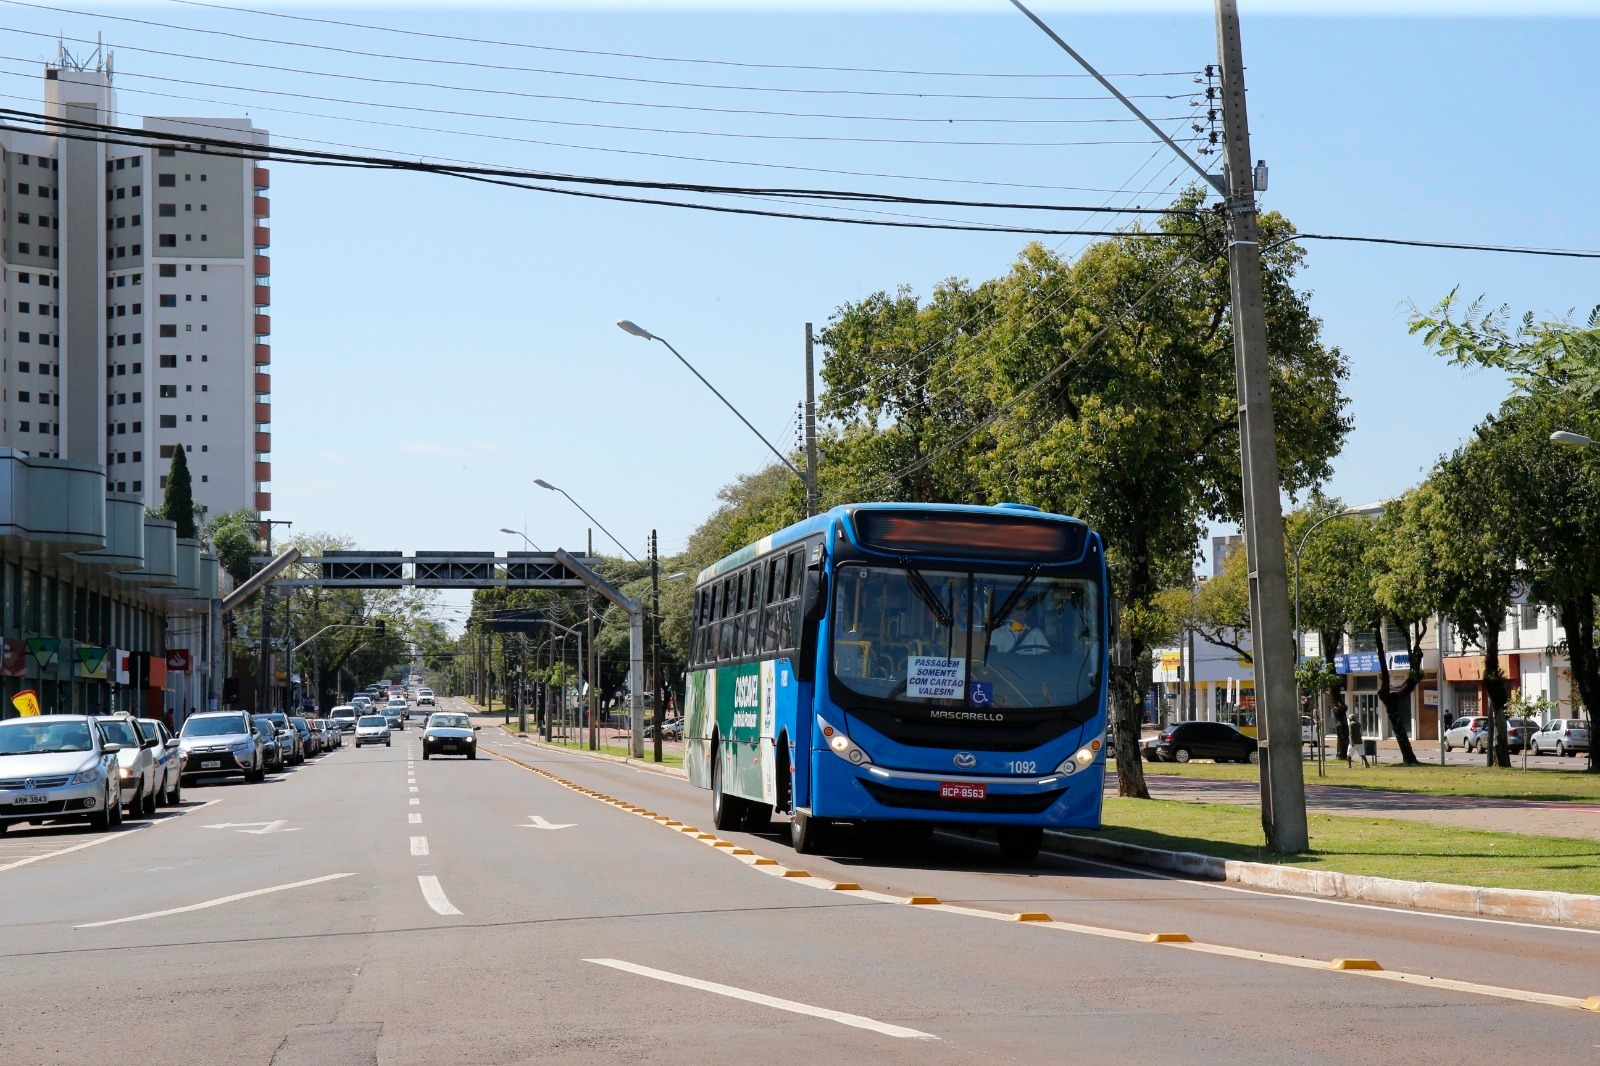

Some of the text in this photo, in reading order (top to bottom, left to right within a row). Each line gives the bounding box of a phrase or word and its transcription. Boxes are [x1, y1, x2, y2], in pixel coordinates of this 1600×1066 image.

[914, 658, 960, 668] PASSAGEM
[916, 668, 957, 677] SOMENTE
[909, 677, 964, 687] COM CARTÃO
[918, 687, 955, 696] VALESIM
[930, 710, 1004, 721] MASCARELLO
[1008, 760, 1037, 774] 1092
